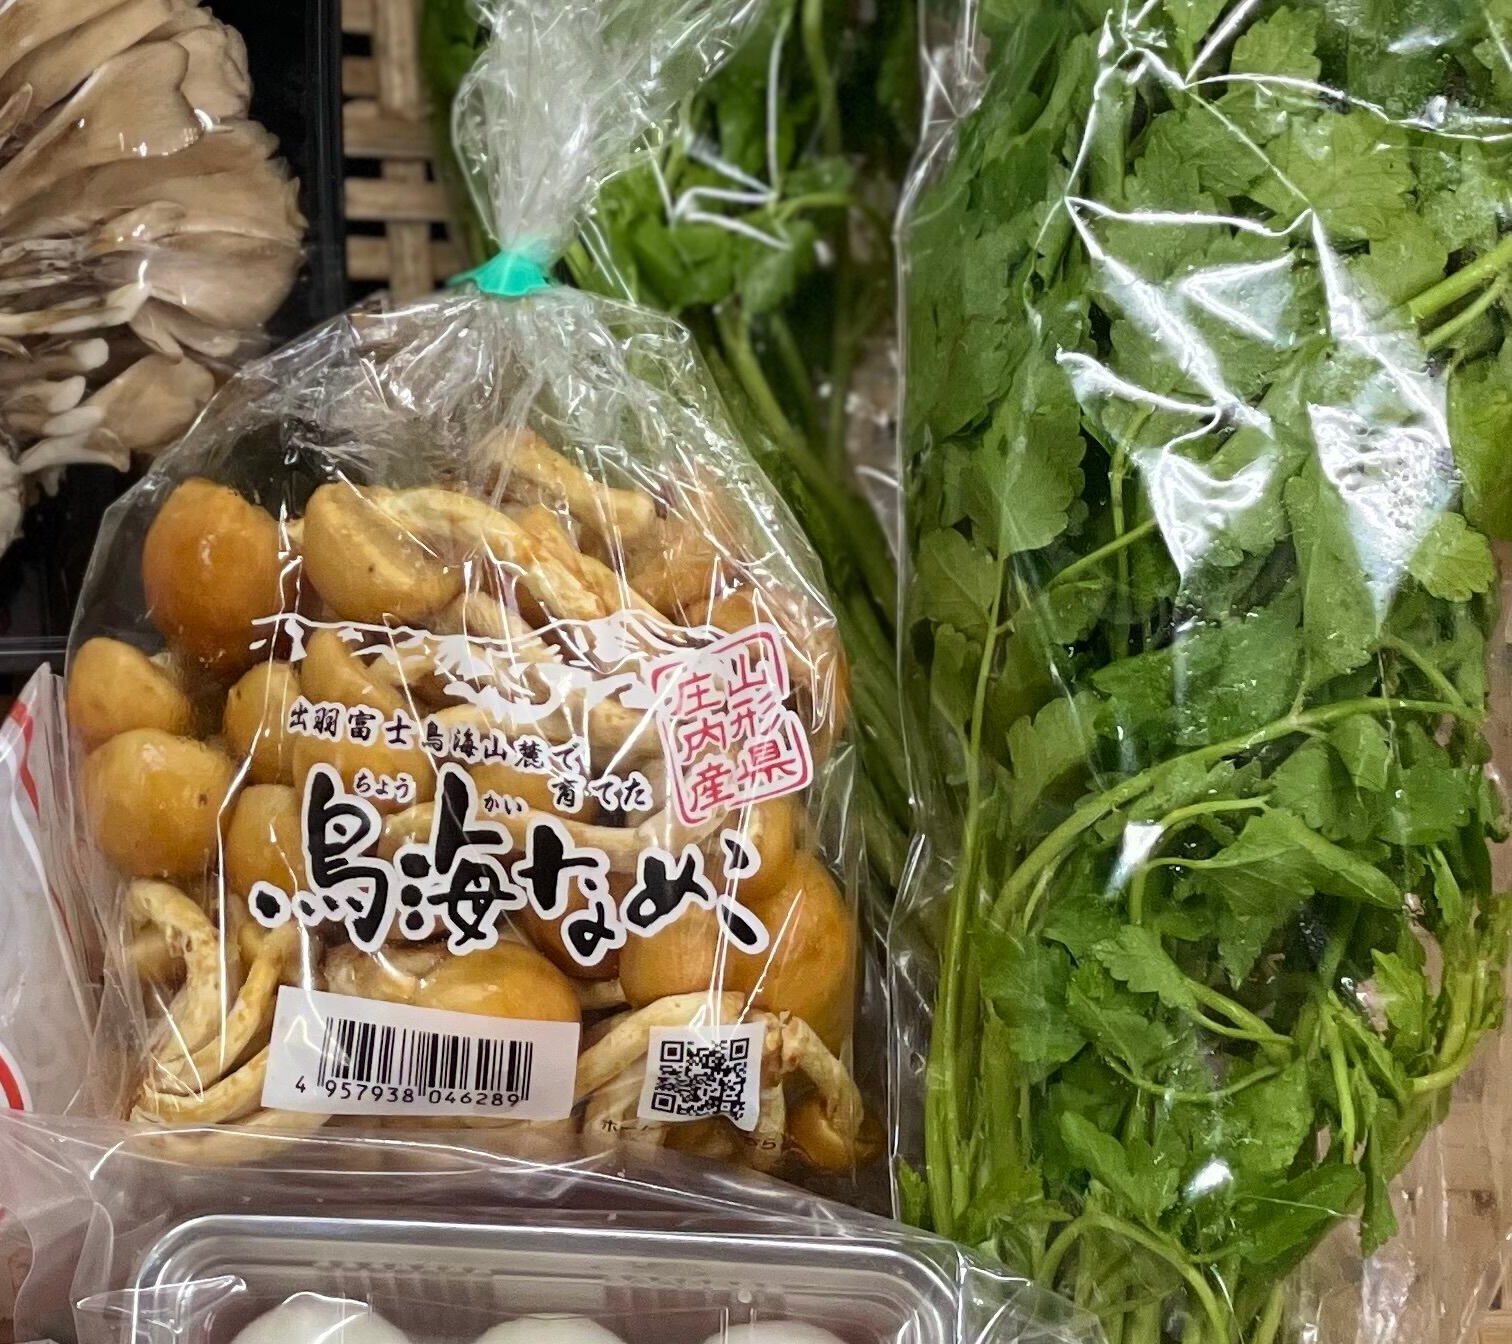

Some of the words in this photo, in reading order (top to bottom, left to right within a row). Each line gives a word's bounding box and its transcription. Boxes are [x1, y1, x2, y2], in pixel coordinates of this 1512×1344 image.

[728, 654, 797, 784] 山形県
[671, 671, 735, 813] 庄内産
[355, 773, 409, 800] ちょう
[483, 794, 523, 815] かい
[552, 777, 647, 809] 育てた
[294, 1074, 306, 1093] 4
[325, 1079, 416, 1105] 957938
[428, 1085, 521, 1109] 046289
